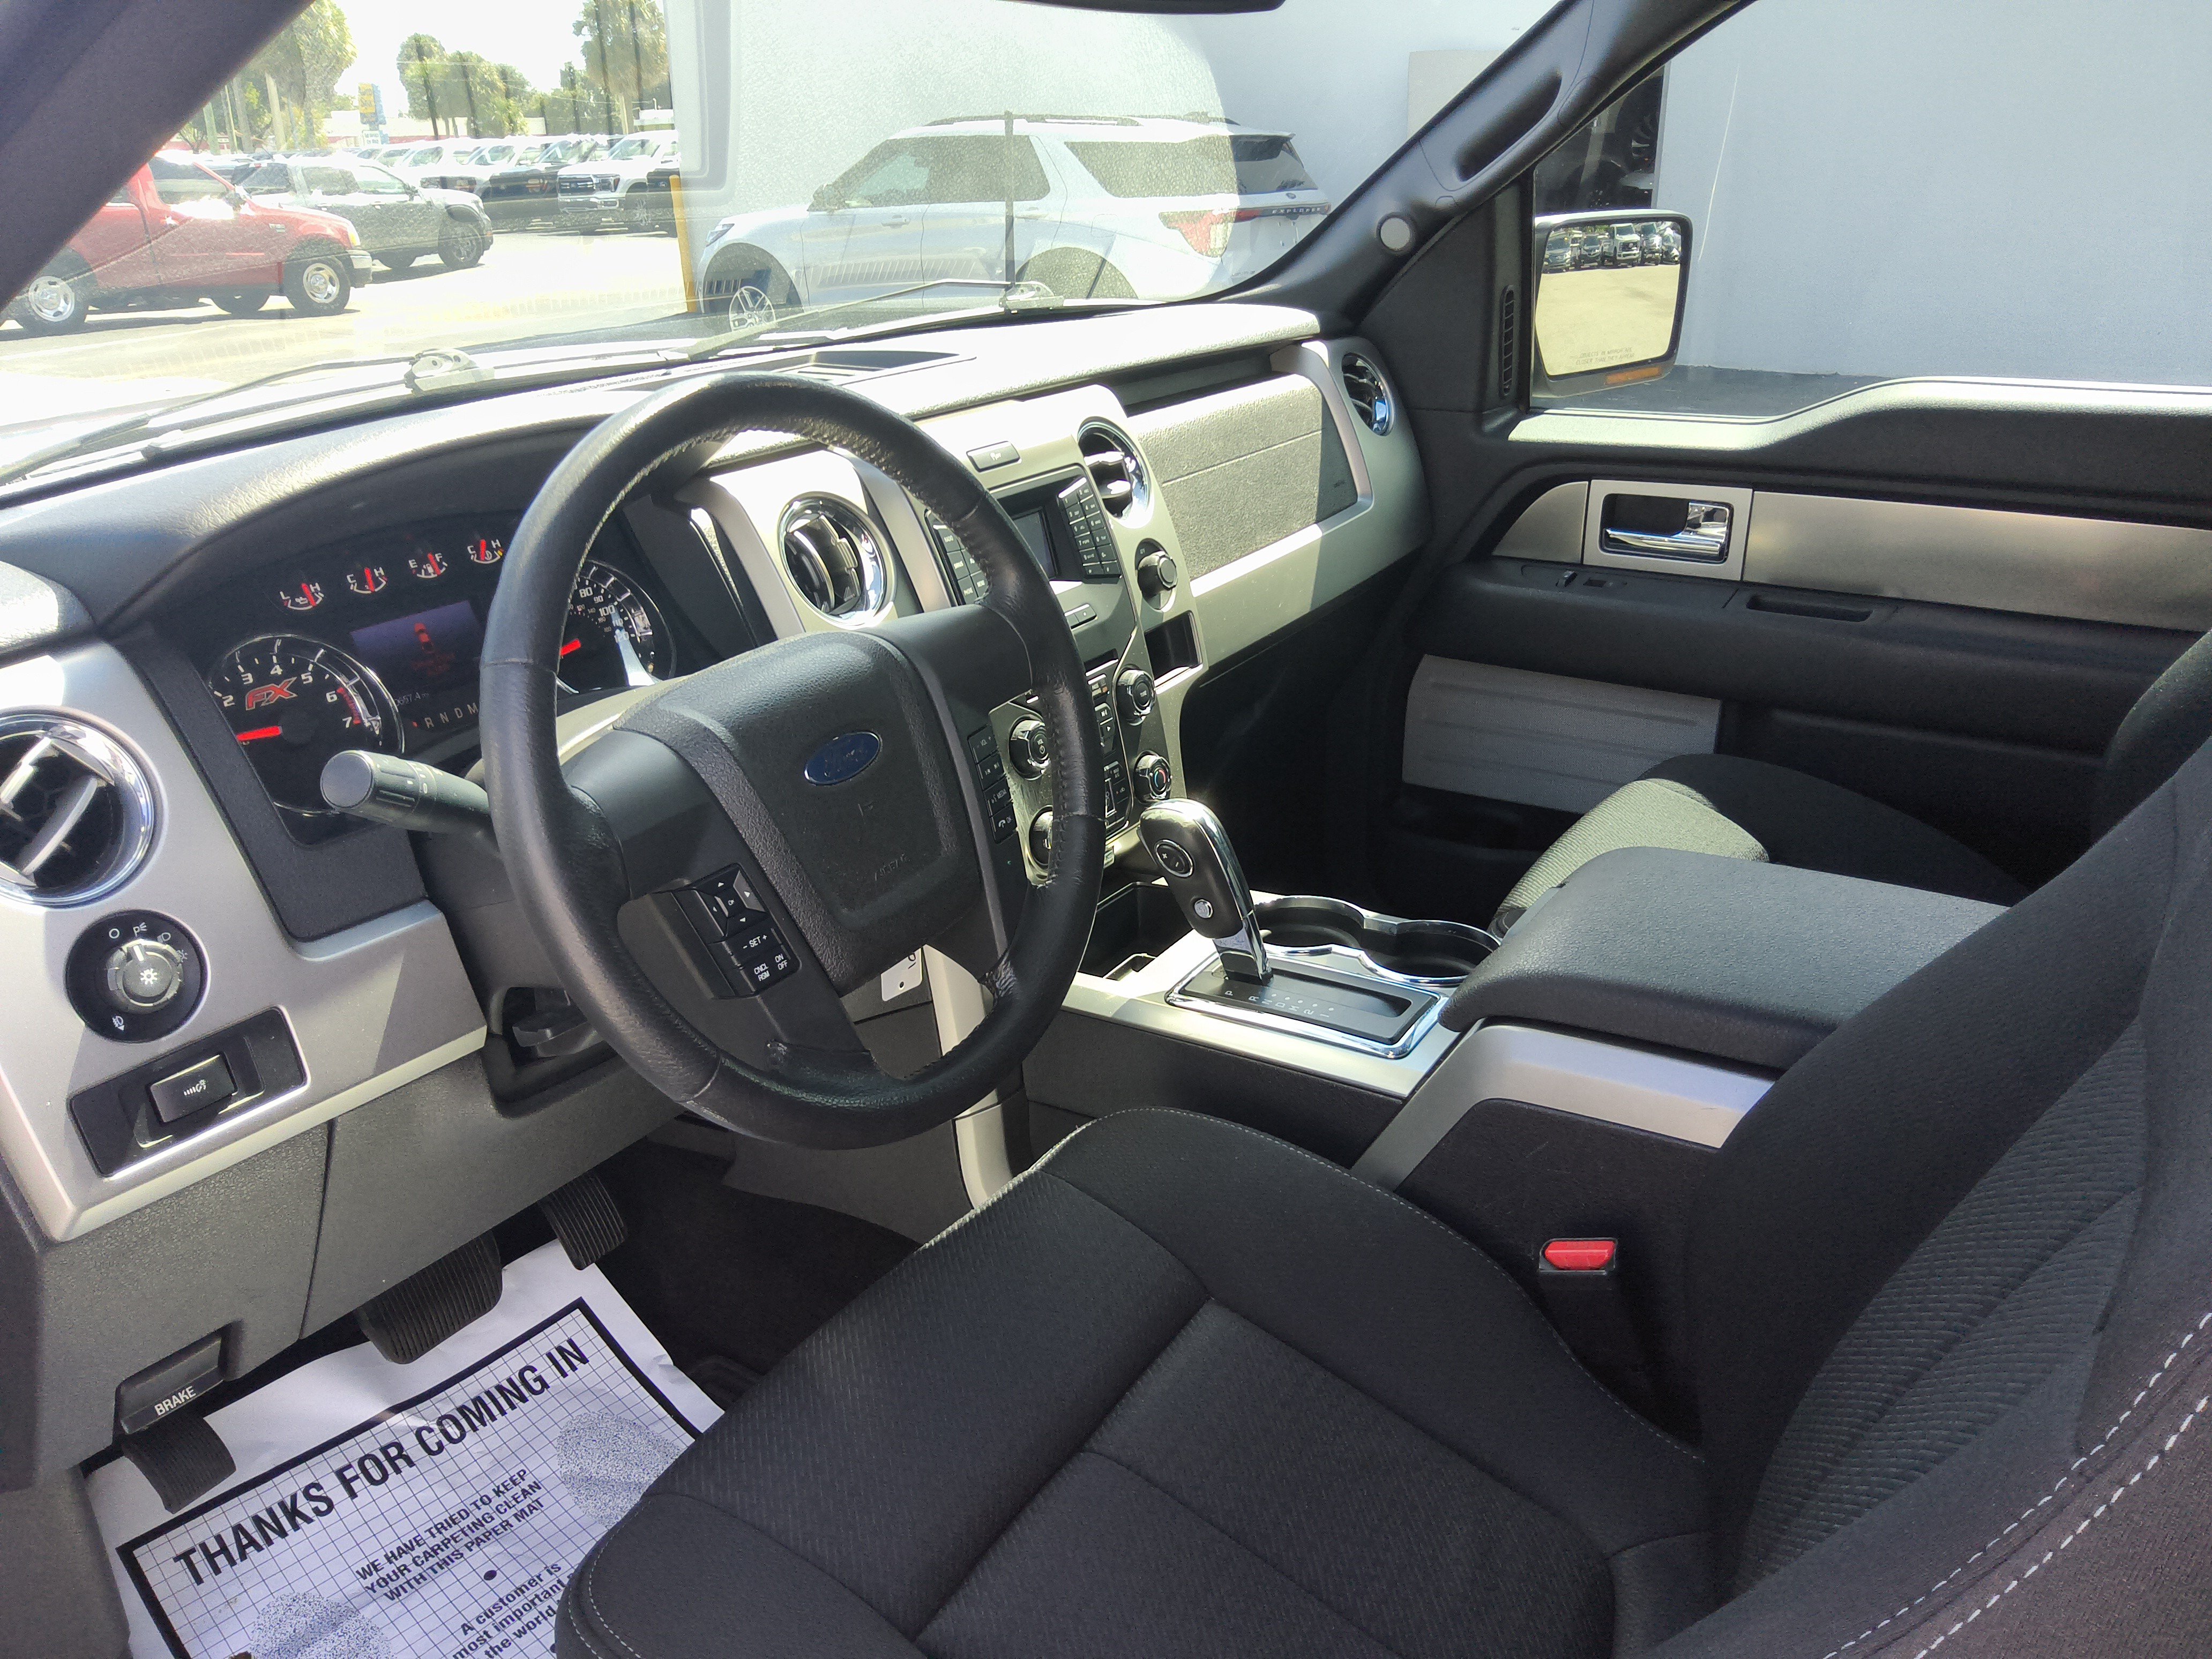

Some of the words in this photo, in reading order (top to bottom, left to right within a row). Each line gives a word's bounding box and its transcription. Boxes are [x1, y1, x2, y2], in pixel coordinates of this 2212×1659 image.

[467, 545, 476, 555] C
[491, 539, 501, 549] H
[408, 559, 418, 569] E
[435, 552, 443, 562] F
[347, 574, 357, 584] C
[373, 566, 385, 577] H
[280, 591, 290, 600] L
[309, 582, 321, 593] H
[579, 587, 593, 598] 80
[593, 595, 604, 604] 90
[599, 604, 616, 617] 100
[270, 664, 283, 675] 4
[241, 672, 253, 685] 3
[301, 672, 313, 684] 5
[222, 694, 235, 707] 2
[326, 691, 338, 702] 6
[424, 716, 435, 729] R
[439, 712, 450, 724] N
[454, 707, 463, 719] D
[467, 702, 479, 715] M
[342, 717, 352, 728] 7
[749, 936, 761, 948] SET
[774, 953, 784, 963] ON
[778, 959, 788, 970] OFF
[753, 963, 769, 975] CNCL
[758, 970, 771, 982] RSM
[154, 1385, 196, 1416] BRAKE
[173, 1482, 334, 1586] THANKS
[334, 1441, 415, 1500] FOR
[415, 1365, 550, 1456] COMING
[545, 1338, 589, 1379] IN
[355, 1558, 385, 1581] WE
[384, 1534, 427, 1564] HAVE
[424, 1508, 470, 1538] TRIED
[470, 1494, 492, 1510] TO
[491, 1469, 528, 1498] KEEP
[365, 1564, 413, 1595] YOUR
[412, 1512, 496, 1568] CARPETING
[495, 1481, 542, 1515] CLEAN
[383, 1573, 428, 1601] WITH
[428, 1549, 464, 1575] THIS
[464, 1519, 514, 1552] PAPER
[513, 1497, 544, 1522] MAT
[460, 1623, 474, 1636] A
[475, 1573, 544, 1625] customer
[543, 1564, 562, 1576] is
[452, 1630, 494, 1659] most
[491, 1578, 566, 1632] important
[483, 1638, 512, 1658] the
[512, 1605, 557, 1639] world
